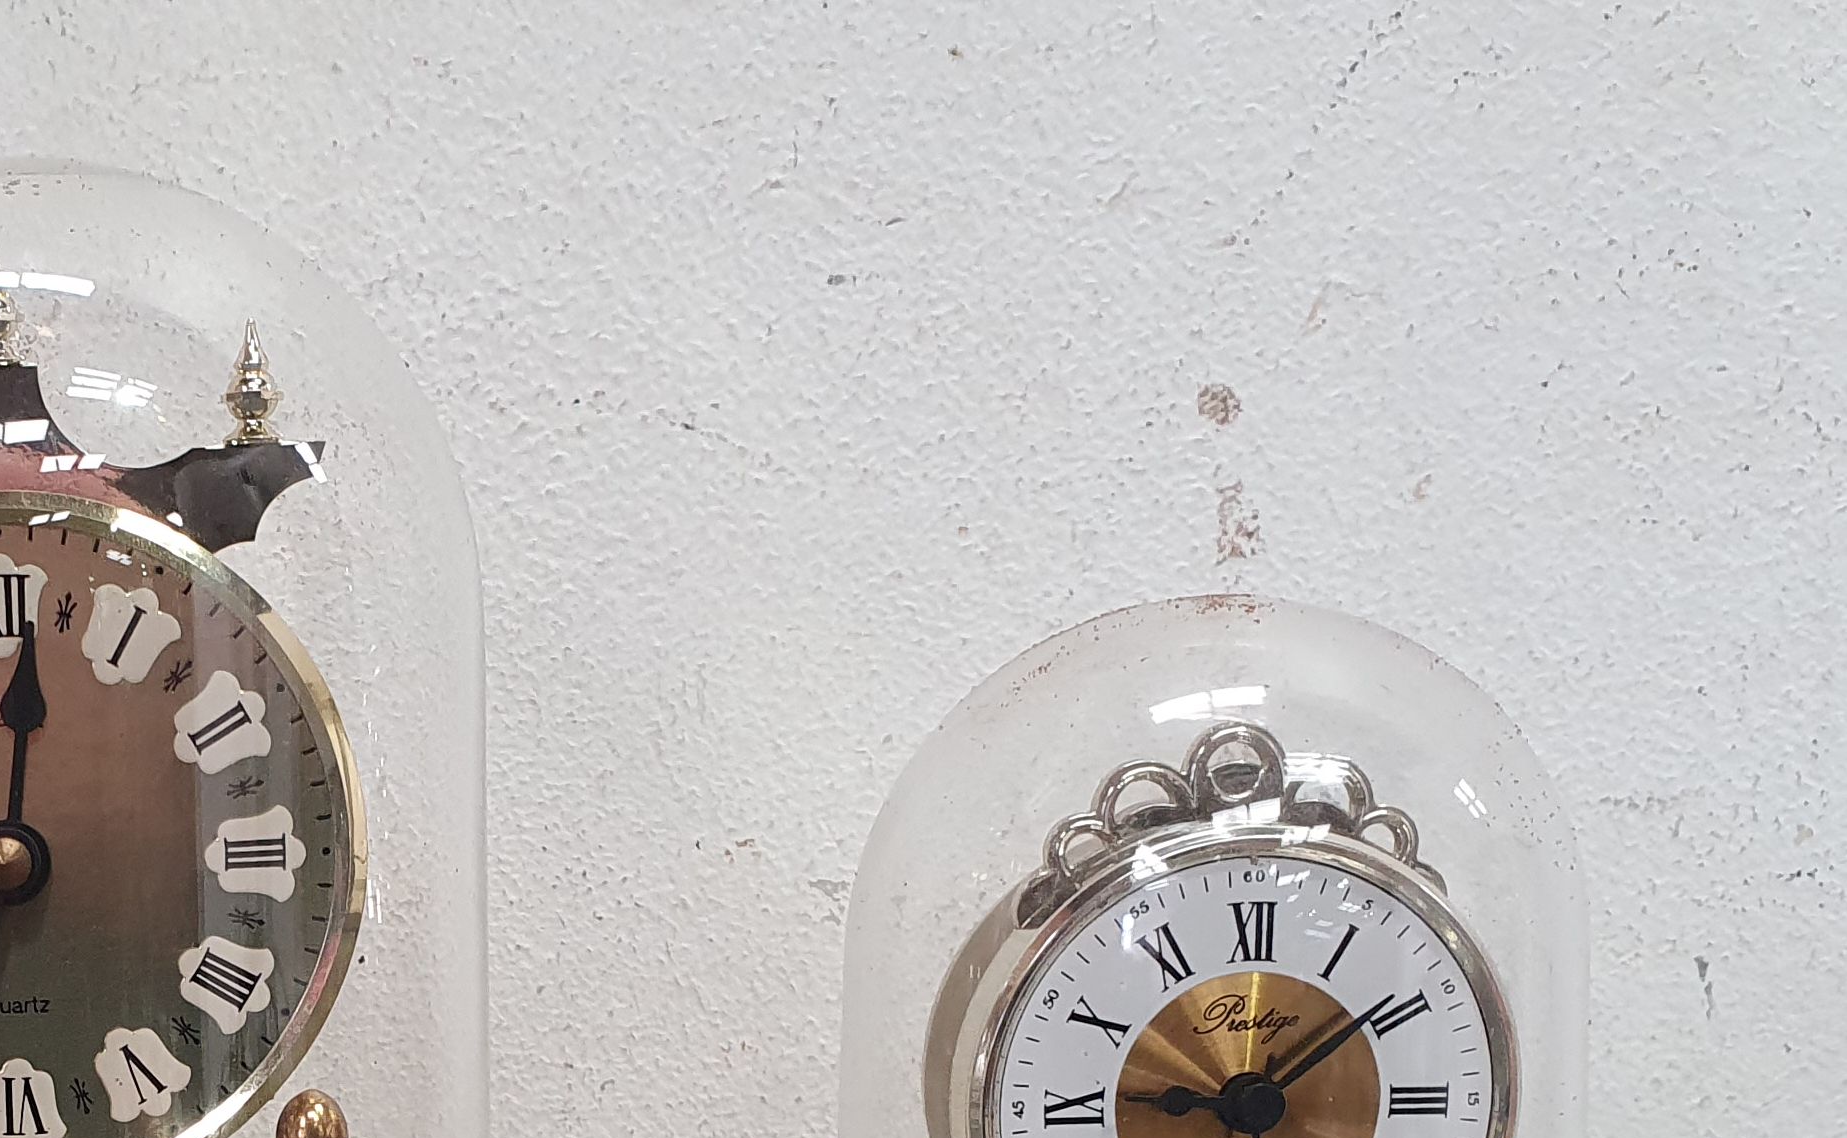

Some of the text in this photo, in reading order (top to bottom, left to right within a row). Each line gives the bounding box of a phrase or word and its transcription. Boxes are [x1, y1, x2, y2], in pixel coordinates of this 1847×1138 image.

[106, 605, 147, 667] I
[188, 701, 252, 770] II
[224, 834, 287, 870] III
[1243, 871, 1265, 882] 60
[1129, 902, 1150, 919] 55
[1361, 899, 1373, 911] 5
[1226, 901, 1278, 963] XII
[1318, 924, 1359, 981] I
[1136, 923, 1195, 991] XI
[1043, 989, 1059, 1008] 50
[1441, 979, 1455, 994] 10
[1067, 995, 1132, 1049] X
[1193, 994, 1300, 1044] Prestige
[1370, 990, 1431, 1039] II
[120, 1046, 168, 1103] V
[2, 1077, 49, 1137] VI
[1013, 1101, 1024, 1119] 45
[1044, 1087, 1106, 1128] IX
[1388, 1082, 1449, 1118] III
[1468, 1091, 1478, 1106] 15
